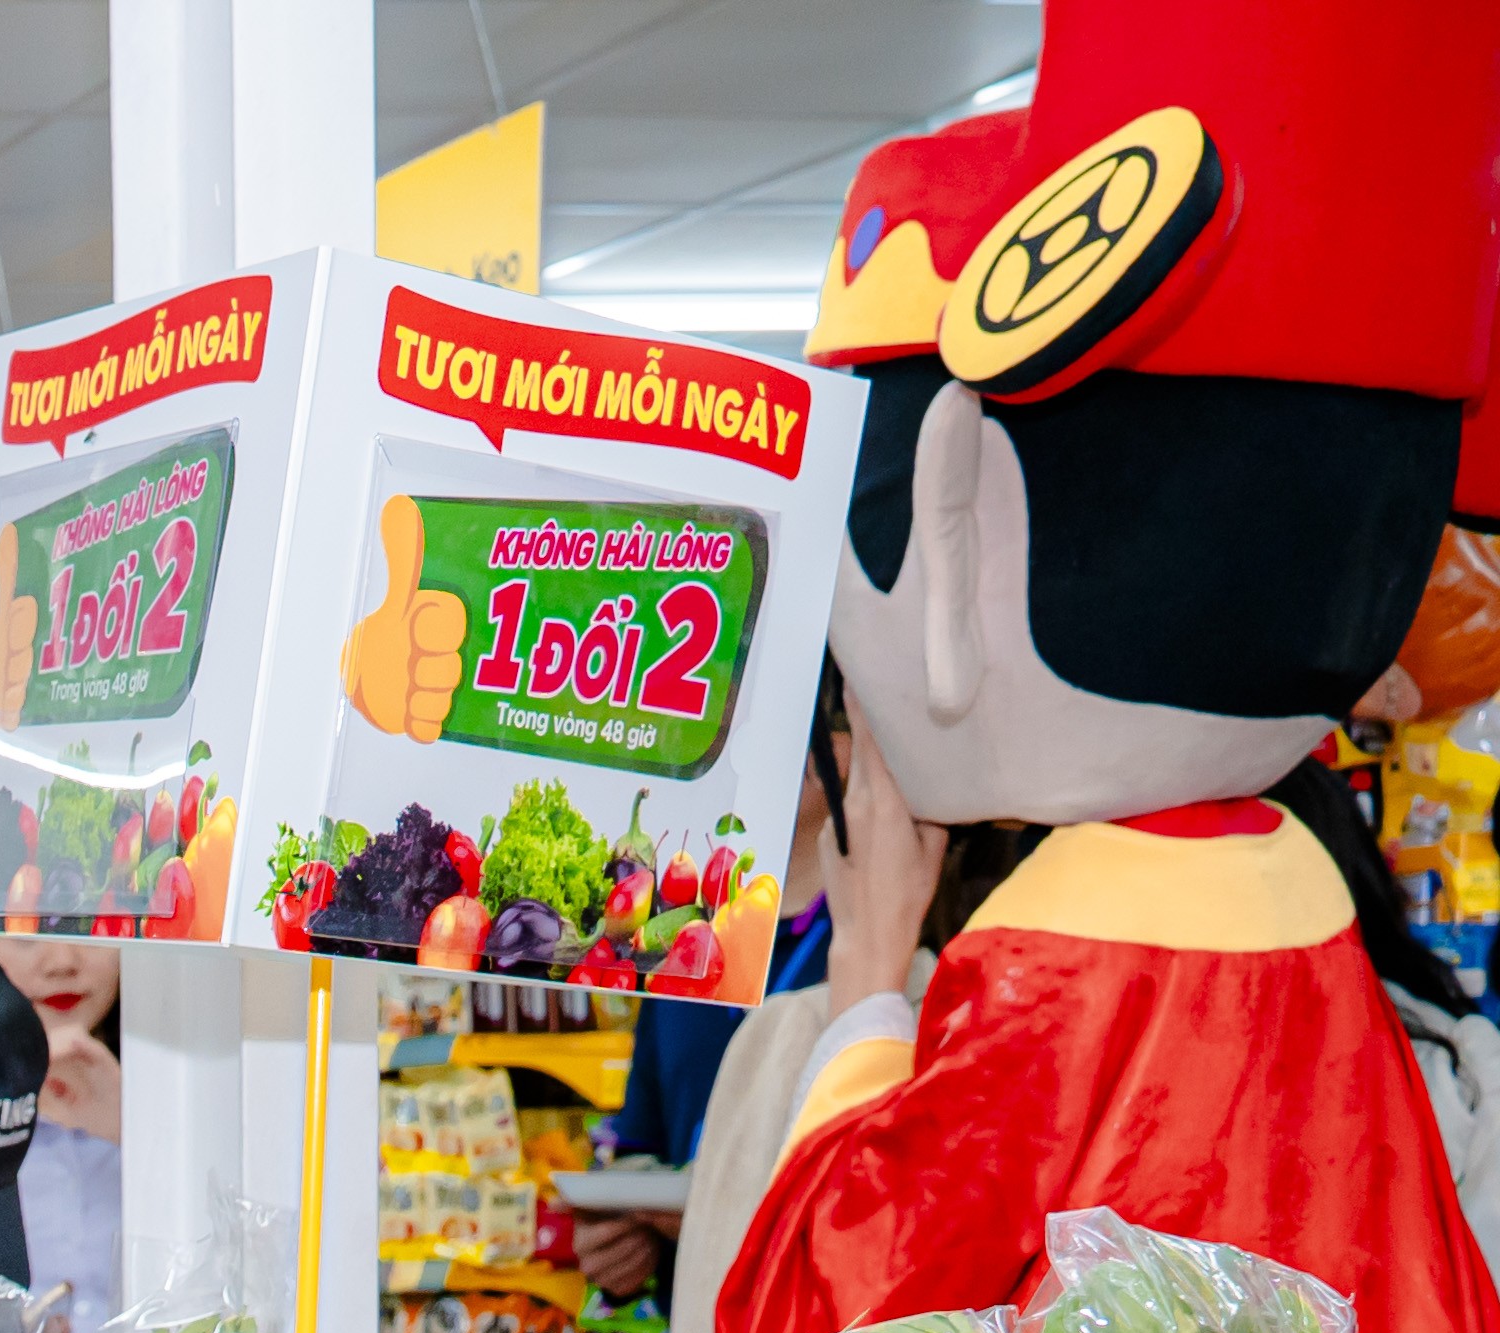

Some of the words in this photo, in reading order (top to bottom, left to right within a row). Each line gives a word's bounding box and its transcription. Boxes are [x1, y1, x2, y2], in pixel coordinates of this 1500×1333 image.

[10, 376, 66, 427] TƯƠI
[66, 345, 119, 417] MỚI
[119, 308, 175, 396] MỖI
[176, 297, 262, 373] NGÀY
[395, 325, 497, 403] TƯƠI
[502, 350, 589, 416] MỚI
[593, 347, 677, 425] MỖI
[682, 382, 798, 455] NGÀY
[52, 500, 116, 562] KHÔNG
[489, 518, 596, 568] KHÔNG
[38, 564, 74, 674] 1
[68, 551, 143, 668] ĐỔI
[137, 516, 197, 656] 2
[50, 680, 79, 702] Trong
[83, 675, 109, 700] vòng
[111, 672, 127, 693] 48
[474, 579, 529, 694] 1
[527, 595, 644, 707] ĐỔI
[638, 581, 721, 720] 2
[497, 702, 549, 736] Trong
[554, 711, 597, 743] vòng
[600, 719, 625, 743] 48
[627, 724, 657, 750] giờ
